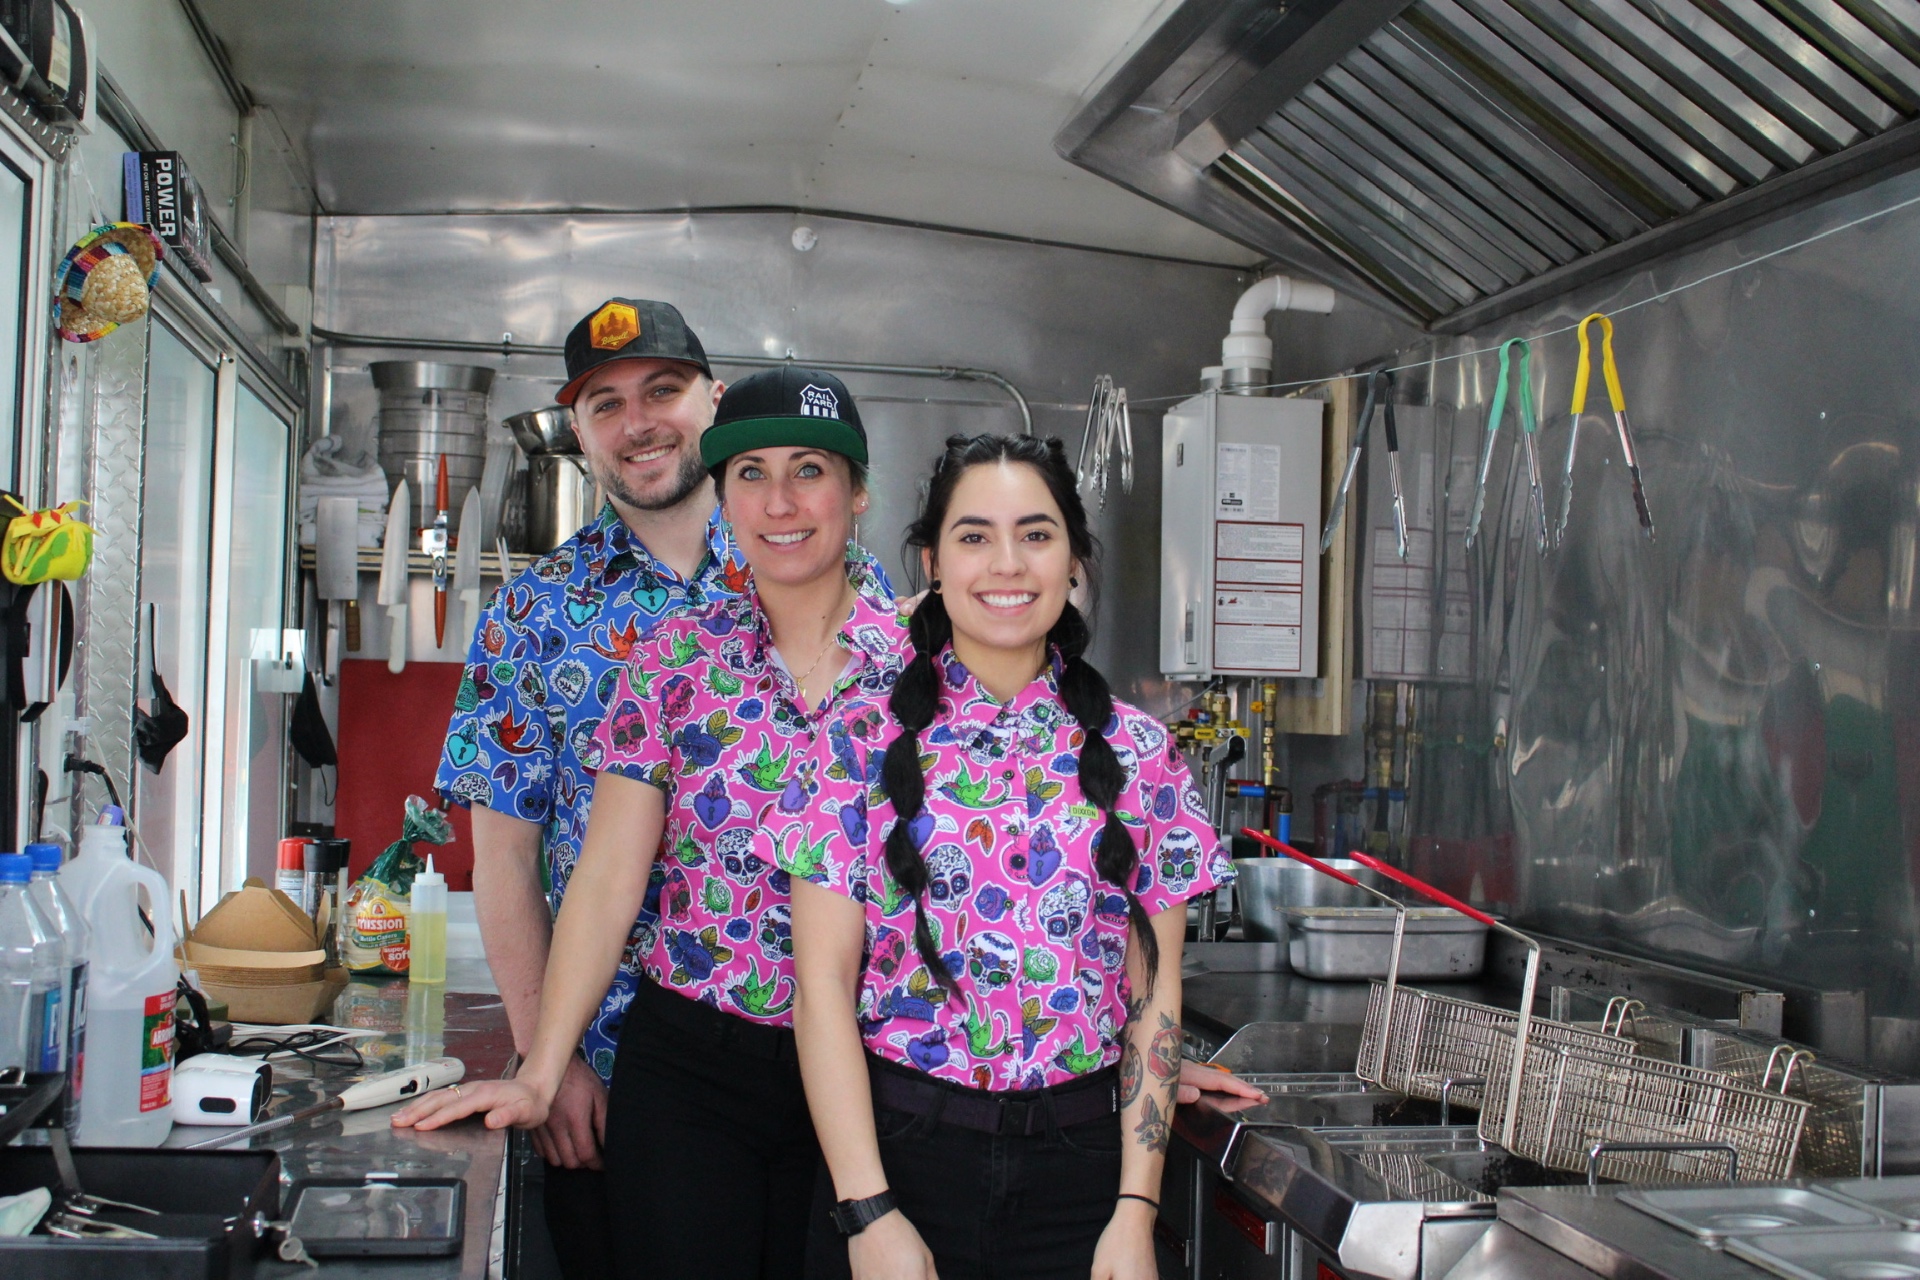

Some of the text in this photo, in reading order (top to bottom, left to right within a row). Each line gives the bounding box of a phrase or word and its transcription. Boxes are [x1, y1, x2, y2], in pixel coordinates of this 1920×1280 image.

[143, 172, 149, 180] ON
[806, 396, 833, 408] YARD
[807, 390, 832, 402] RAIL
